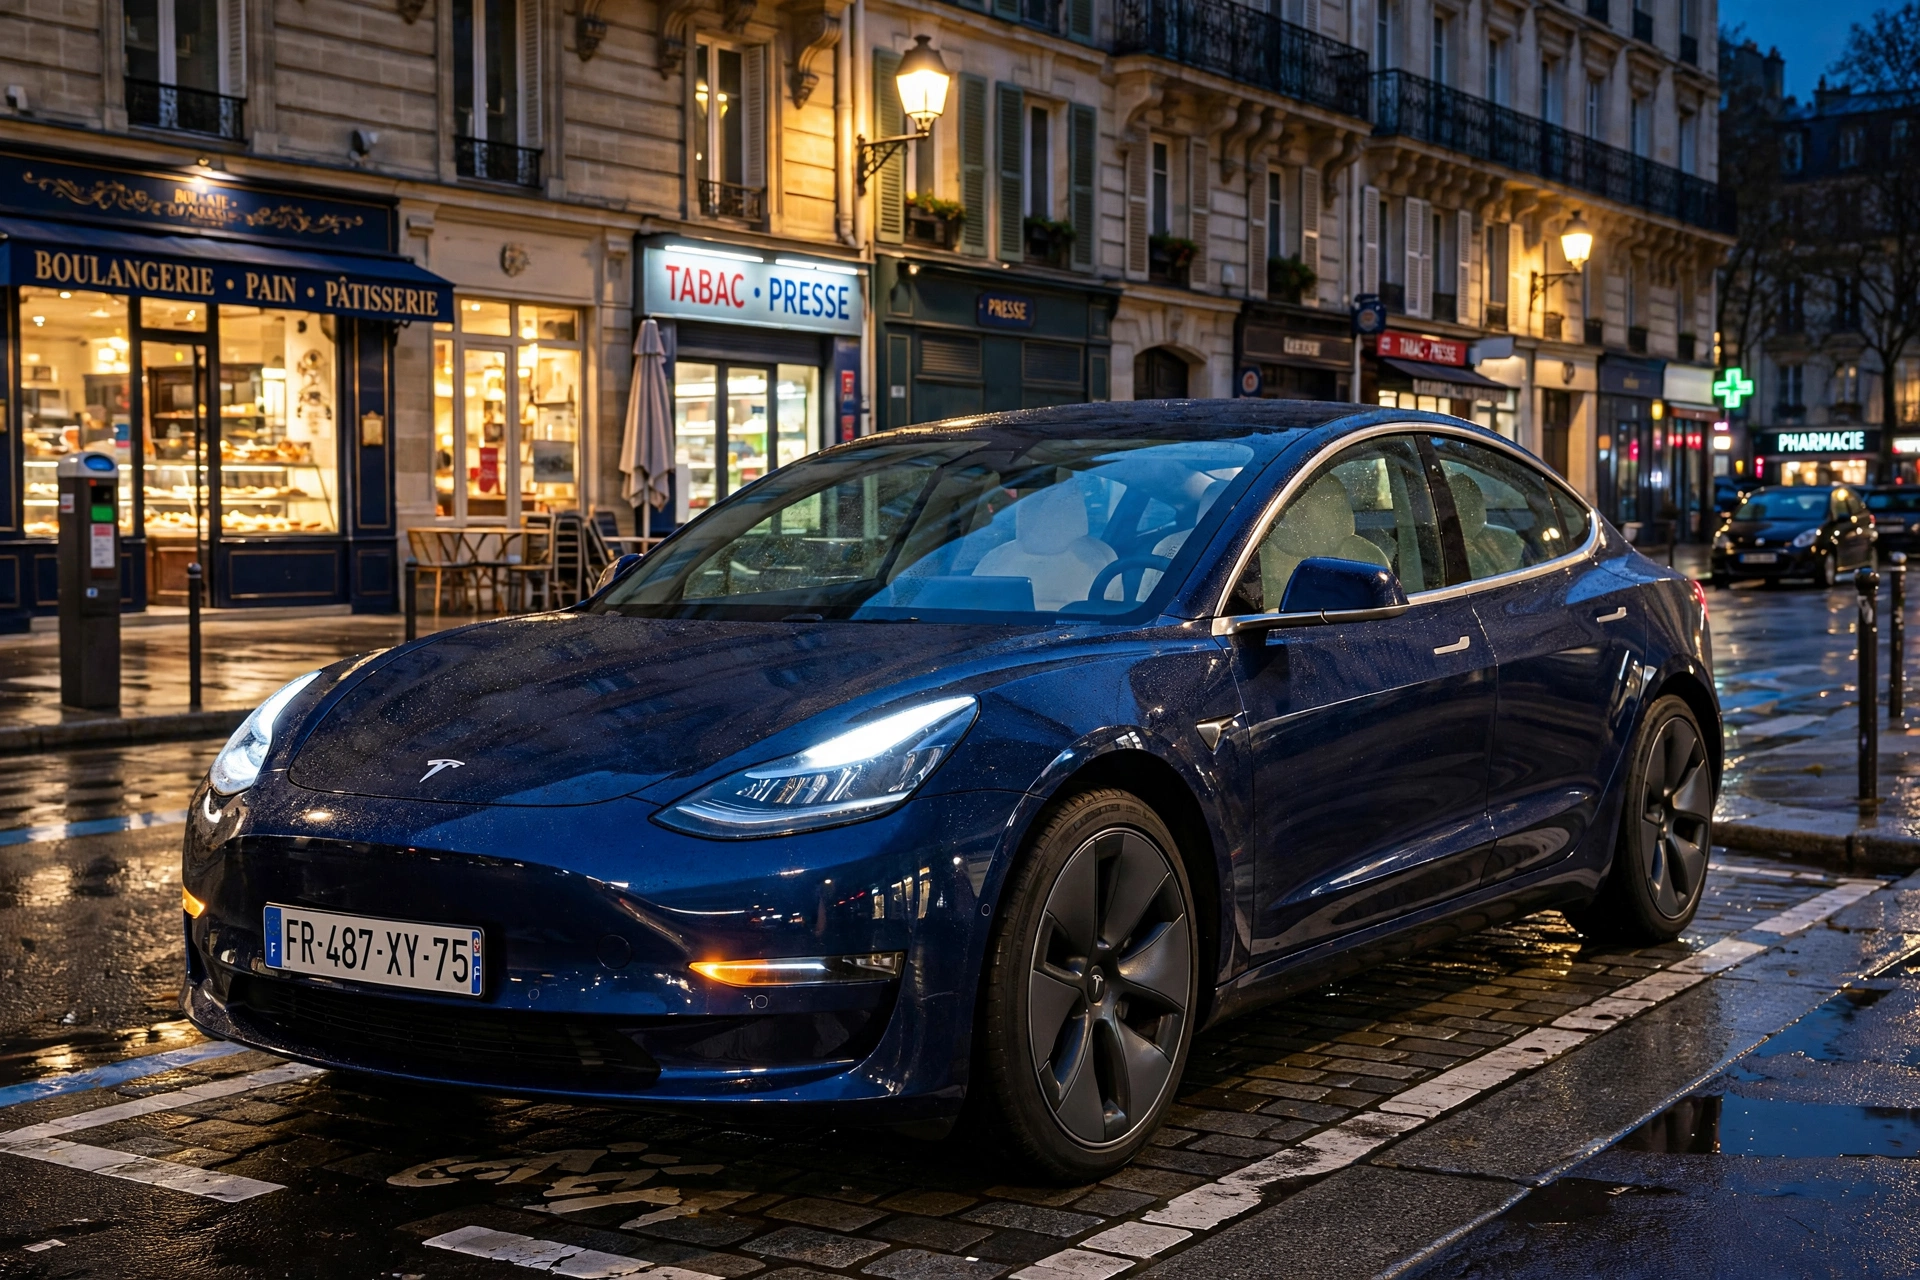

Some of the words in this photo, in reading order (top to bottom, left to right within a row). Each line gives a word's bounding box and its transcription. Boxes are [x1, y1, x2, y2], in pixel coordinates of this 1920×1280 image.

[35, 250, 215, 296] BOULANGERIE
[246, 272, 296, 303] PAIN
[325, 276, 439, 316] PÂTISSERIE
[665, 264, 745, 309] TABAC
[769, 277, 850, 320] PRESSE
[988, 298, 1027, 320] PRESSE
[1778, 431, 1865, 452] PHARMACIE
[270, 942, 277, 958] F
[286, 918, 469, 983] FR-487-XY-75
